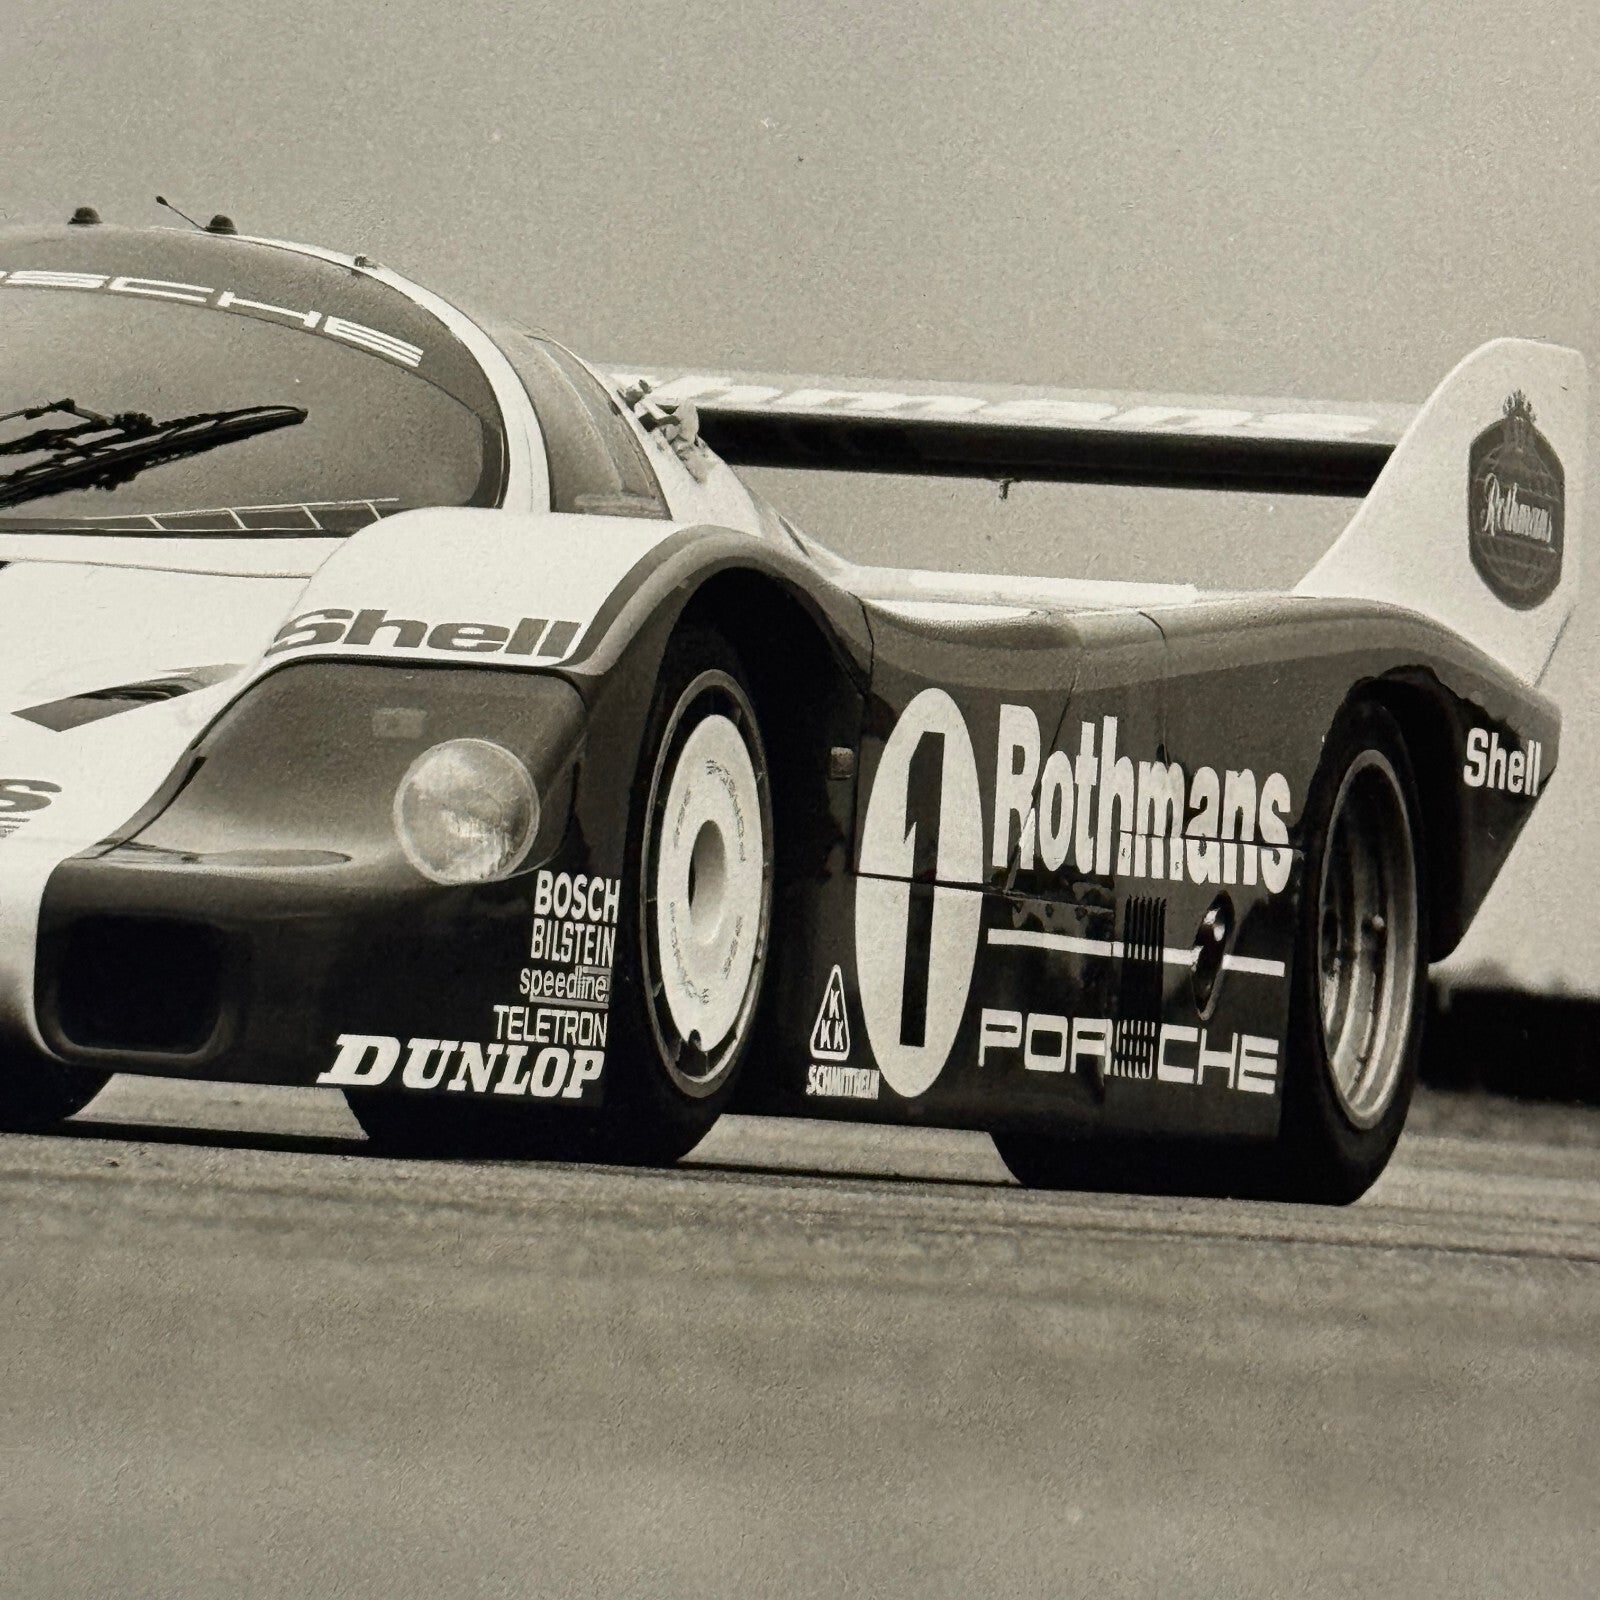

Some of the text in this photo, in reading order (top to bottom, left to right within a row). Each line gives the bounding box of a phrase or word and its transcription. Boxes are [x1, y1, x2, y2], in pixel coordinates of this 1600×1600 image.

[0, 270, 423, 367] SCHE
[264, 608, 583, 658] Shell
[1463, 727, 1542, 797] Shell
[992, 703, 1294, 894] Rothmans
[534, 869, 621, 924] BOSCH
[900, 730, 946, 1048] 1
[530, 917, 616, 968] BILSTEIN
[519, 965, 609, 1003] speedline
[493, 1004, 609, 1048] TELETRON
[978, 1008, 1279, 1095] PORSCHE
[316, 1033, 605, 1099] DUNLOP
